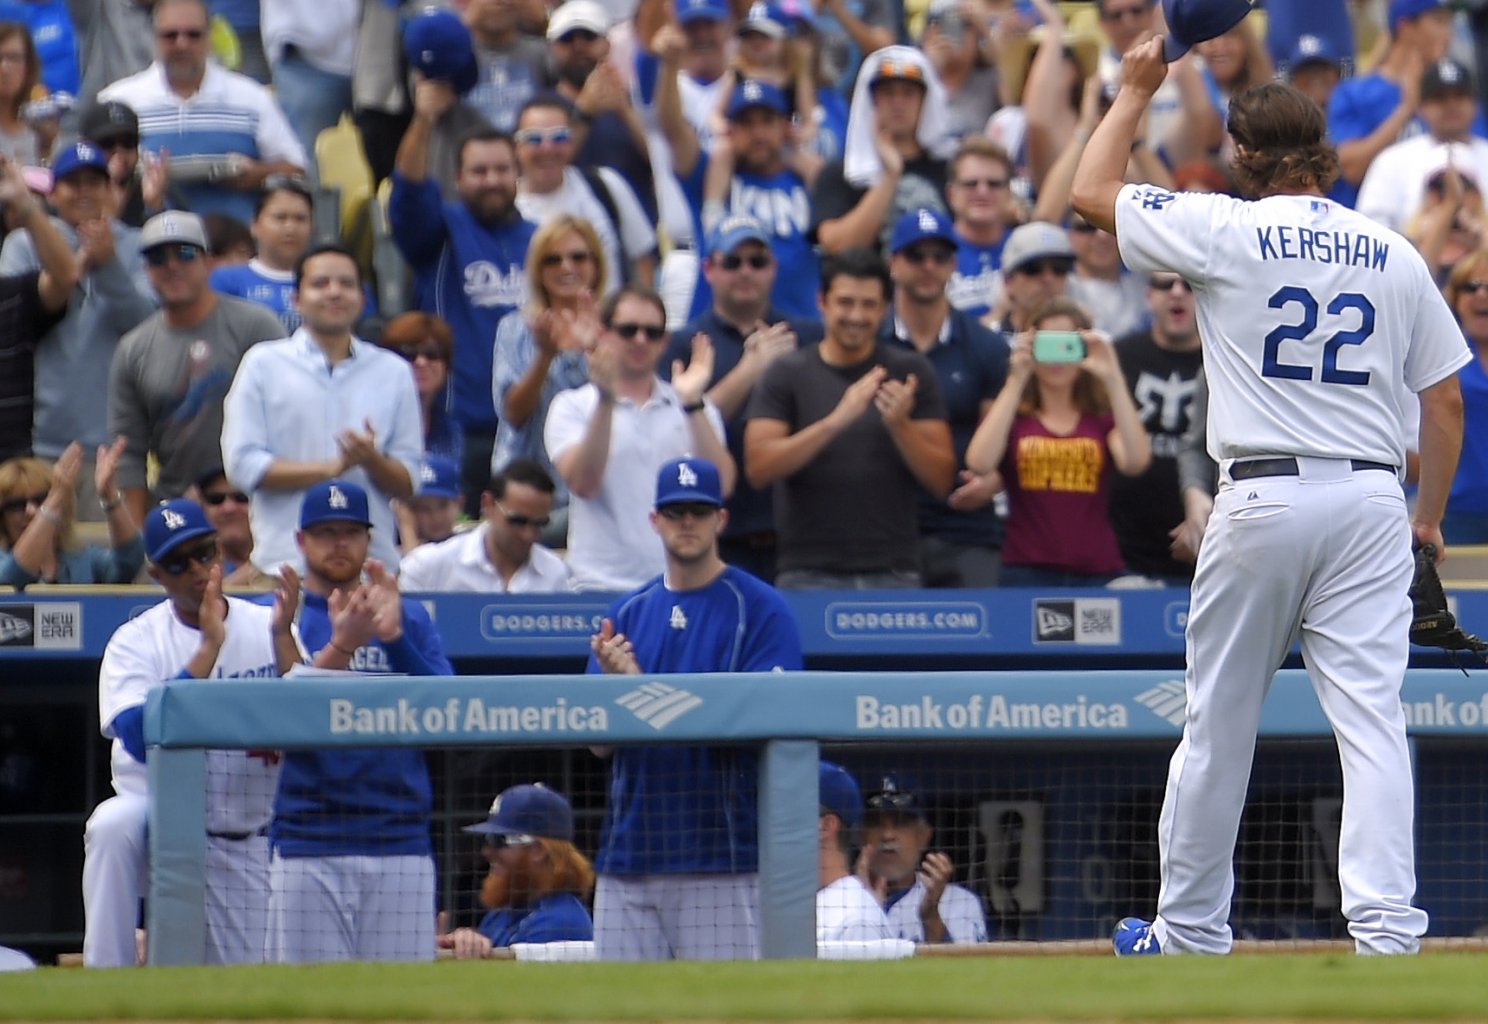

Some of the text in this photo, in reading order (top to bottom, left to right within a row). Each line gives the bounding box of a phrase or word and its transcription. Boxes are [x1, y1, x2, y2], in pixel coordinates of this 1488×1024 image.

[1256, 225, 1390, 273] KERSHAW
[1261, 285, 1376, 385] 22
[328, 484, 349, 510] LA
[161, 508, 186, 530] LA
[41, 612, 74, 625] NEW
[493, 614, 603, 632] DODGERS.C
[836, 612, 978, 628] DODGERS.COM
[41, 626, 74, 638] ERA
[329, 698, 609, 734] Bank of America
[856, 694, 1128, 729] Bank of America
[1402, 694, 1456, 726] ank
